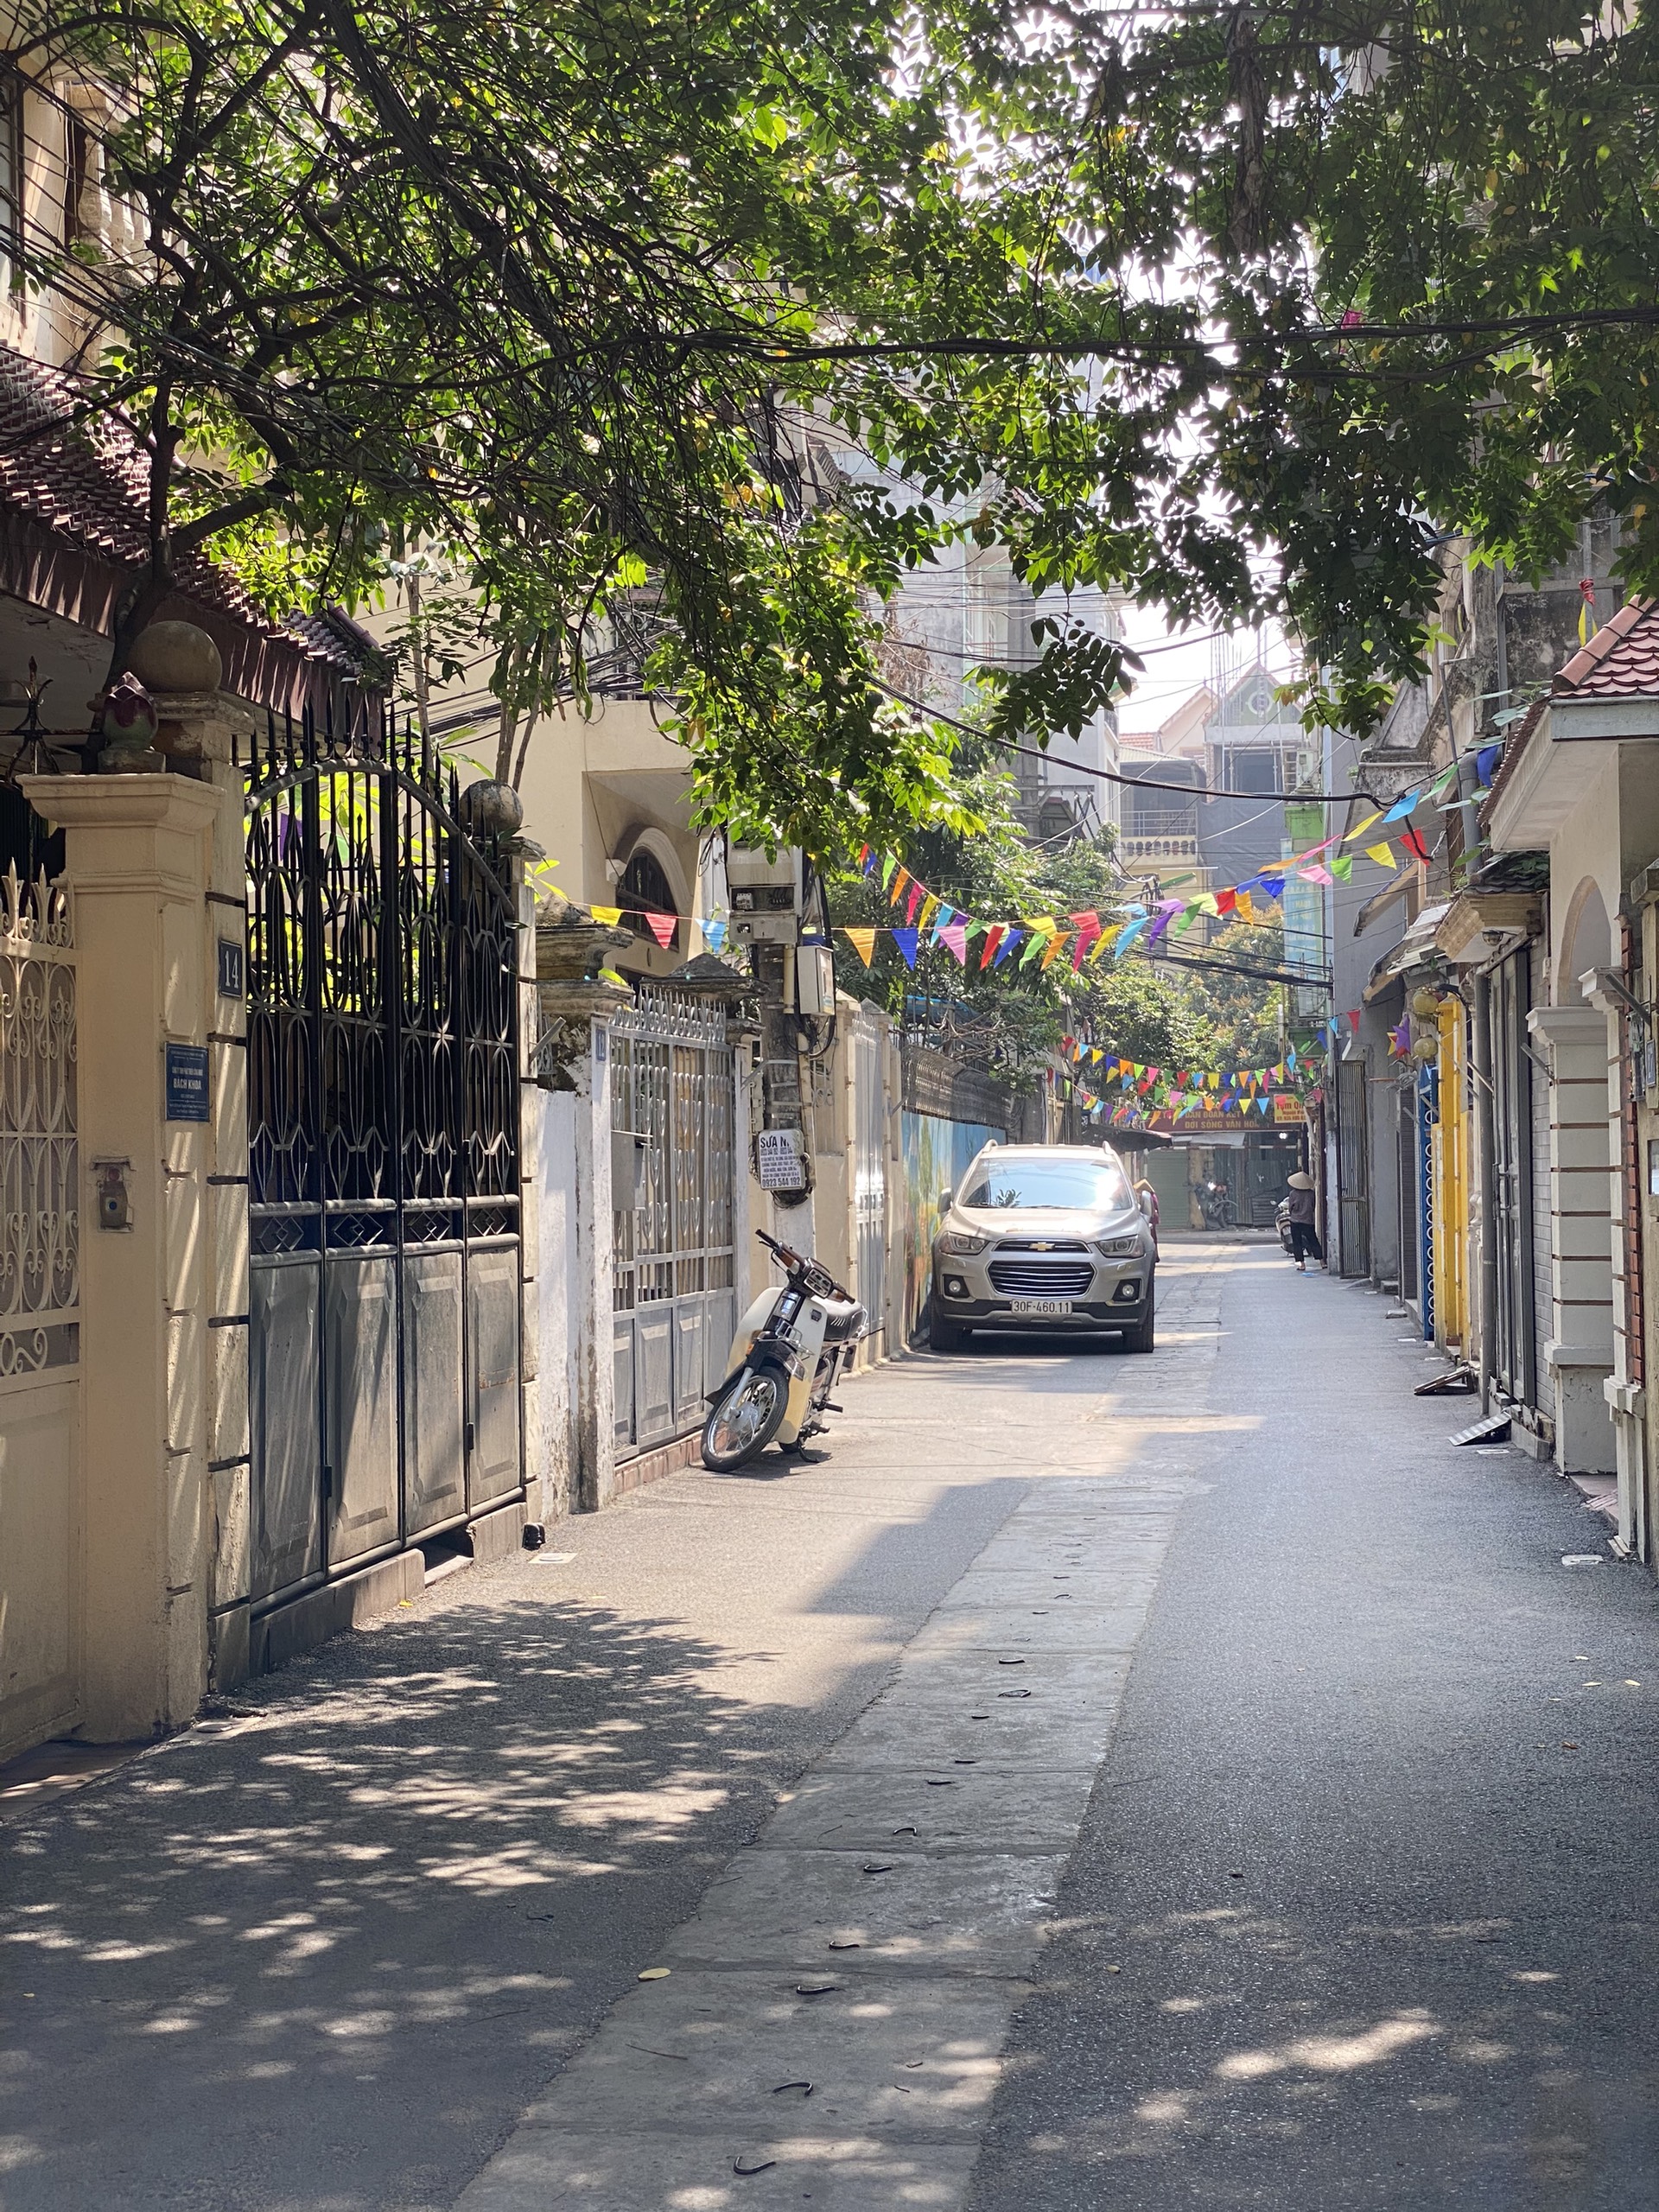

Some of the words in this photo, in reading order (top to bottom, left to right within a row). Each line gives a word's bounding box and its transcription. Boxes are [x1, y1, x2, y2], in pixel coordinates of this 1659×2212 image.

[225, 950, 238, 988] 14
[762, 1179, 777, 1187] 0923
[778, 1177, 789, 1186] 544
[790, 1176, 800, 1185] 192
[1014, 1300, 1069, 1313] 30F-460.11
